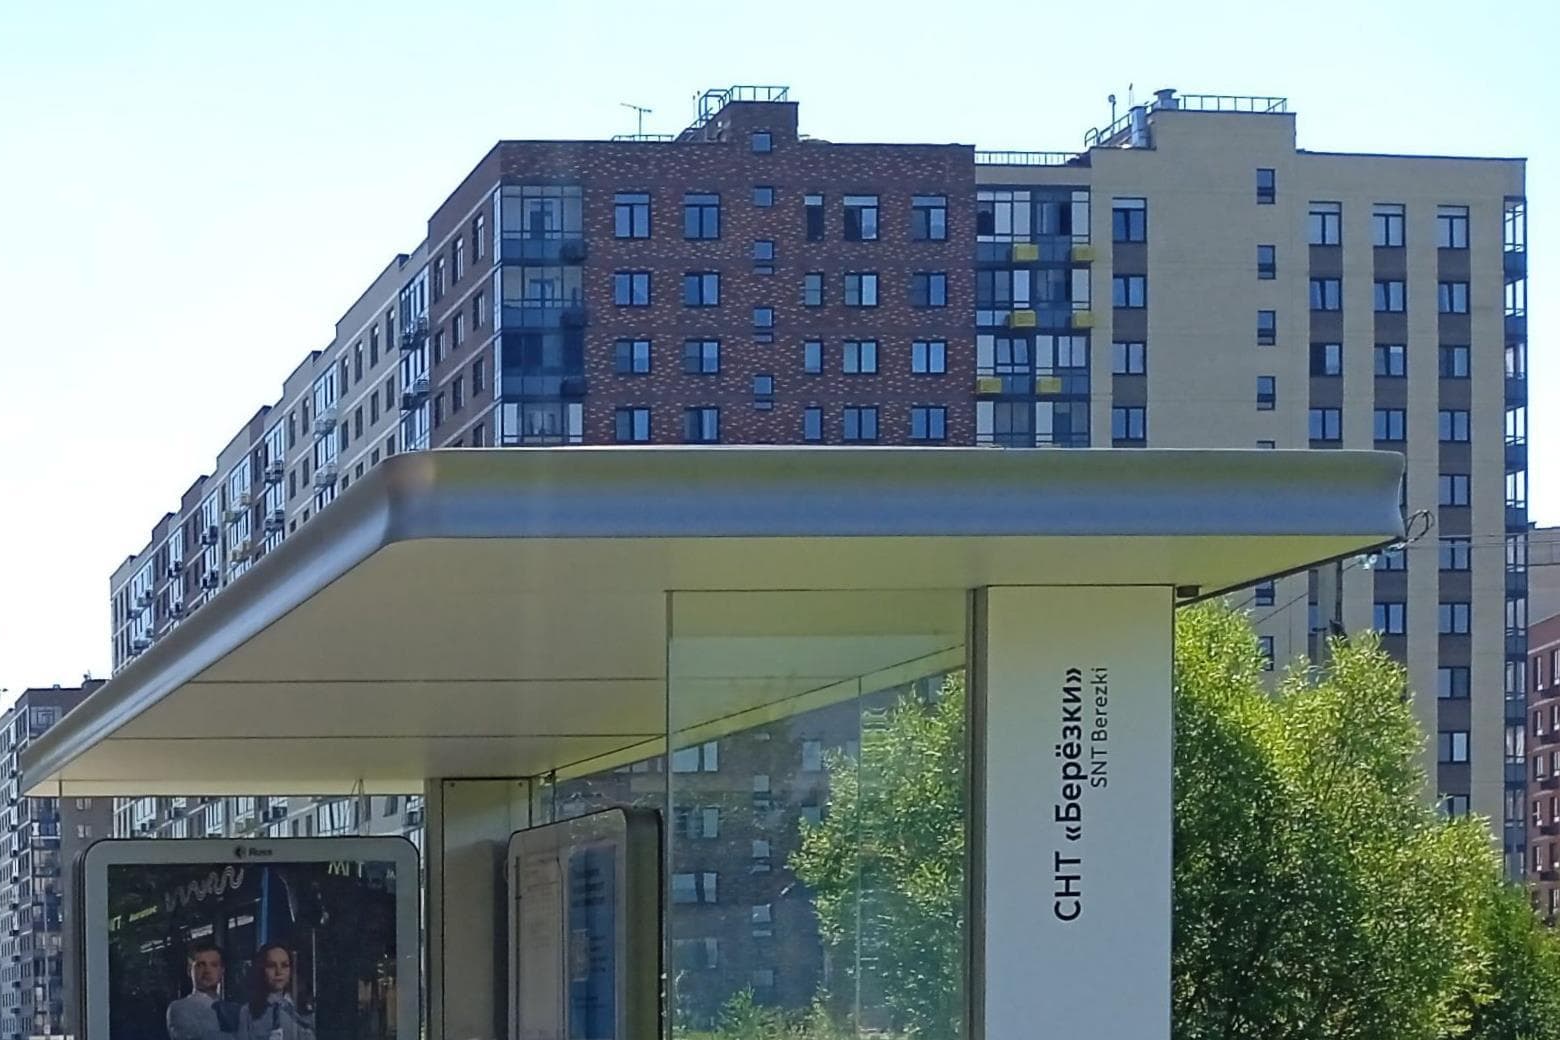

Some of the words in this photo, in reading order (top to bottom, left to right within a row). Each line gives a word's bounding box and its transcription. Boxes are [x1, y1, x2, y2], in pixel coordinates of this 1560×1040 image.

[1090, 667, 1108, 741] Berezki
[1055, 667, 1088, 841] «Берёзки»
[1090, 746, 1108, 788] SNT
[1054, 851, 1081, 921] СНТ
